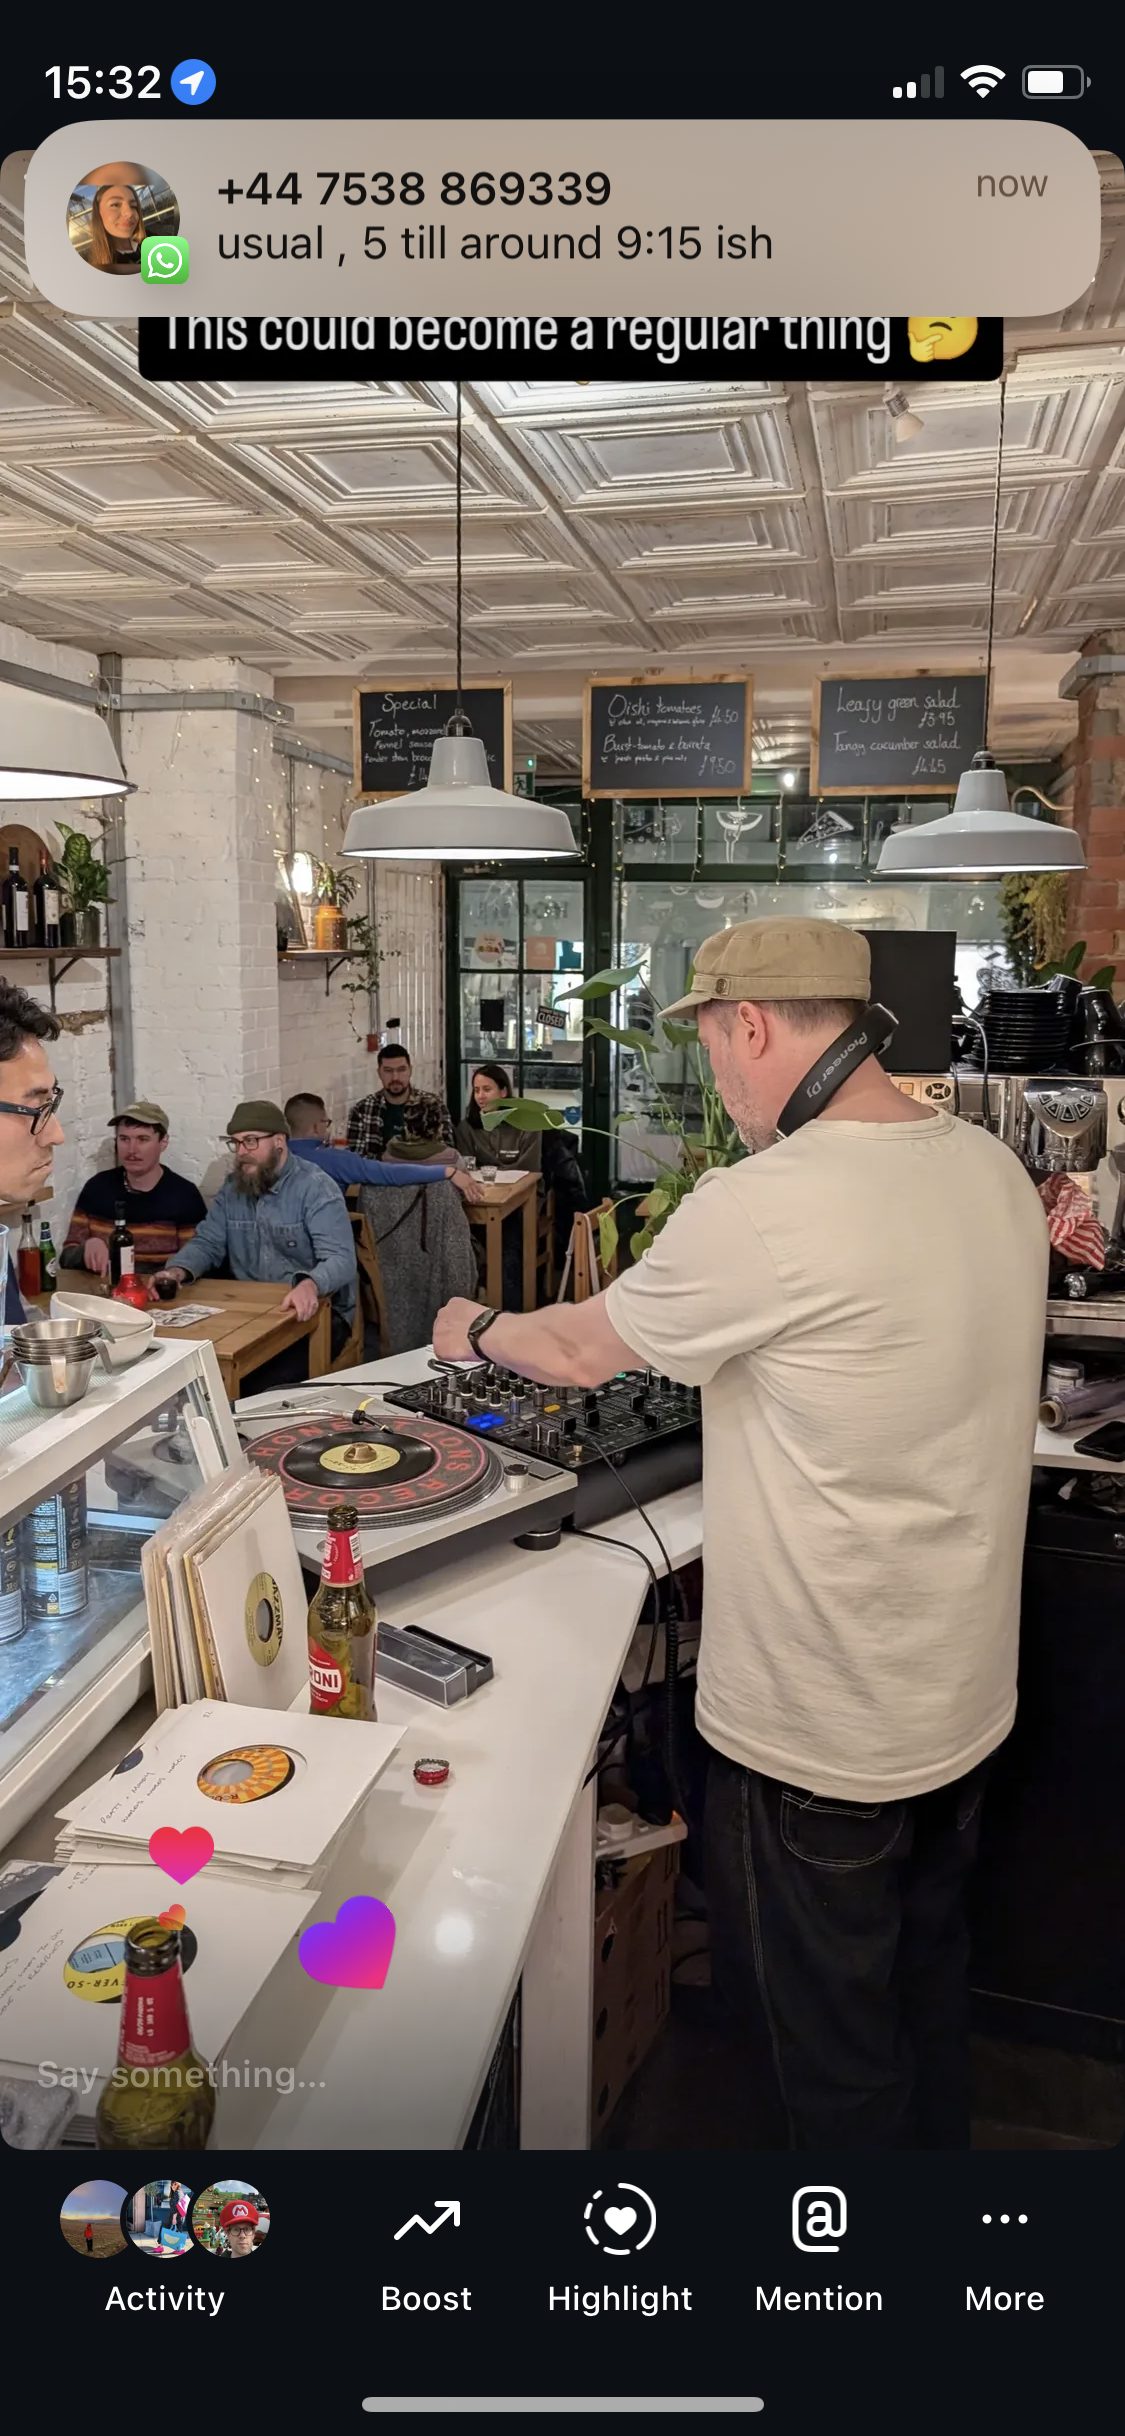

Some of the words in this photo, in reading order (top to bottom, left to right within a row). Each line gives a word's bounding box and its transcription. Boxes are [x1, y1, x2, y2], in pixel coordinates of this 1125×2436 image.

[381, 693, 437, 719] Special
[607, 694, 650, 718] Oishi
[836, 686, 883, 723] Leafy
[887, 696, 919, 721] green
[923, 687, 960, 710] salad
[833, 730, 866, 756] Tangy
[869, 737, 920, 752] cucumber
[922, 731, 960, 750] salad
[537, 1011, 565, 1028] CLOSED
[821, 1031, 868, 1082] Pioneer
[806, 1081, 823, 1099] DJ
[254, 1417, 413, 1459] HONET
[422, 1430, 474, 1472] JONS
[284, 1478, 449, 1506] RECOR
[66, 1977, 124, 1989] VER-SO
